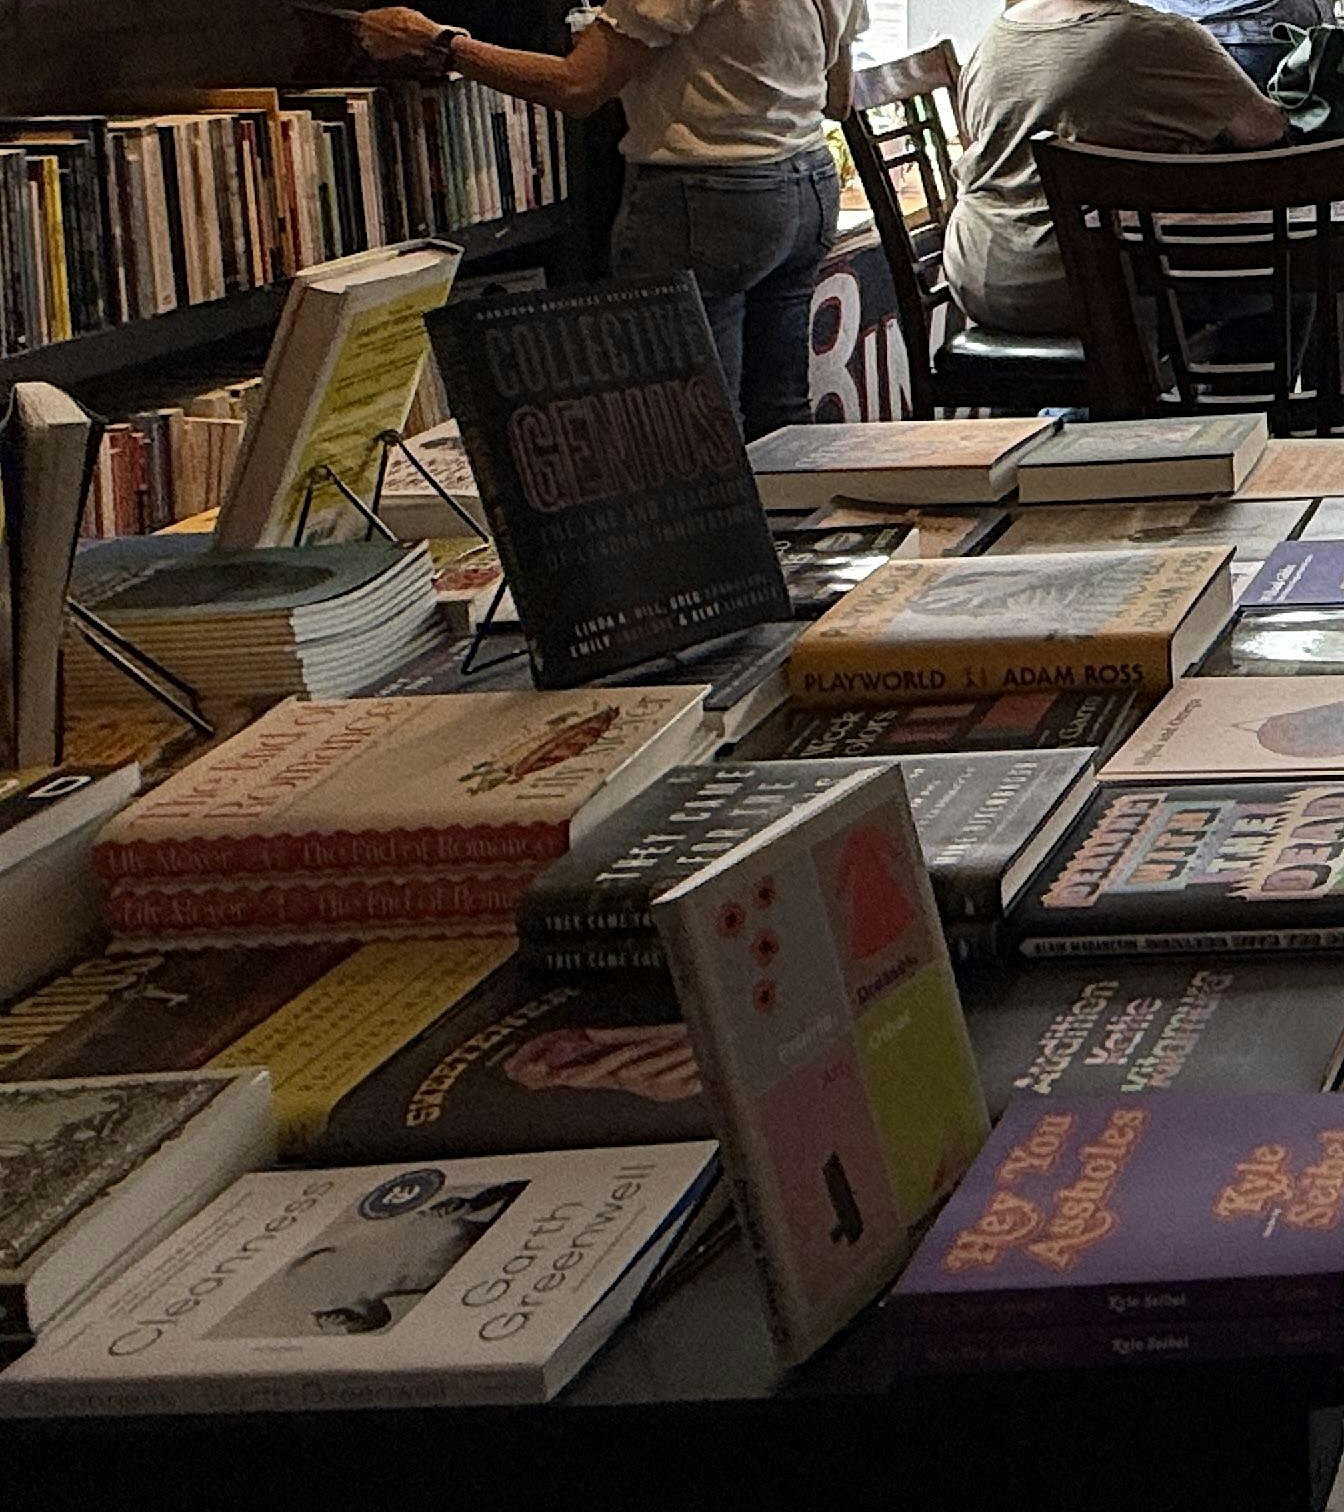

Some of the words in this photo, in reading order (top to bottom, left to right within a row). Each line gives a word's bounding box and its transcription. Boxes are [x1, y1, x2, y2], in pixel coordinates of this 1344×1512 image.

[485, 303, 706, 398] COLLECTIVE
[508, 374, 738, 514] GENIUS
[803, 668, 947, 692] PLAYWORLD
[1003, 666, 1075, 686] ADAM
[1085, 664, 1144, 685] ROSS
[594, 833, 685, 882] THEY
[669, 769, 755, 822] CAME
[730, 780, 796, 816] THE
[301, 834, 348, 869] The
[351, 832, 396, 864] End
[1126, 806, 1218, 884] WITH
[1208, 813, 1284, 880] THE
[940, 1190, 1044, 1274] Hey
[1001, 1110, 1075, 1182] You
[1026, 1107, 1149, 1273] Assholes
[1212, 1142, 1293, 1219] Kyle
[108, 1180, 336, 1357] Cleanness
[460, 1201, 585, 1310] Garth
[478, 1162, 658, 1343] Greenwell
[1108, 1293, 1145, 1313] Kyle
[1148, 1293, 1188, 1308] Seibel
[1111, 1337, 1146, 1356] Kyle
[1148, 1335, 1189, 1350] Seibel
